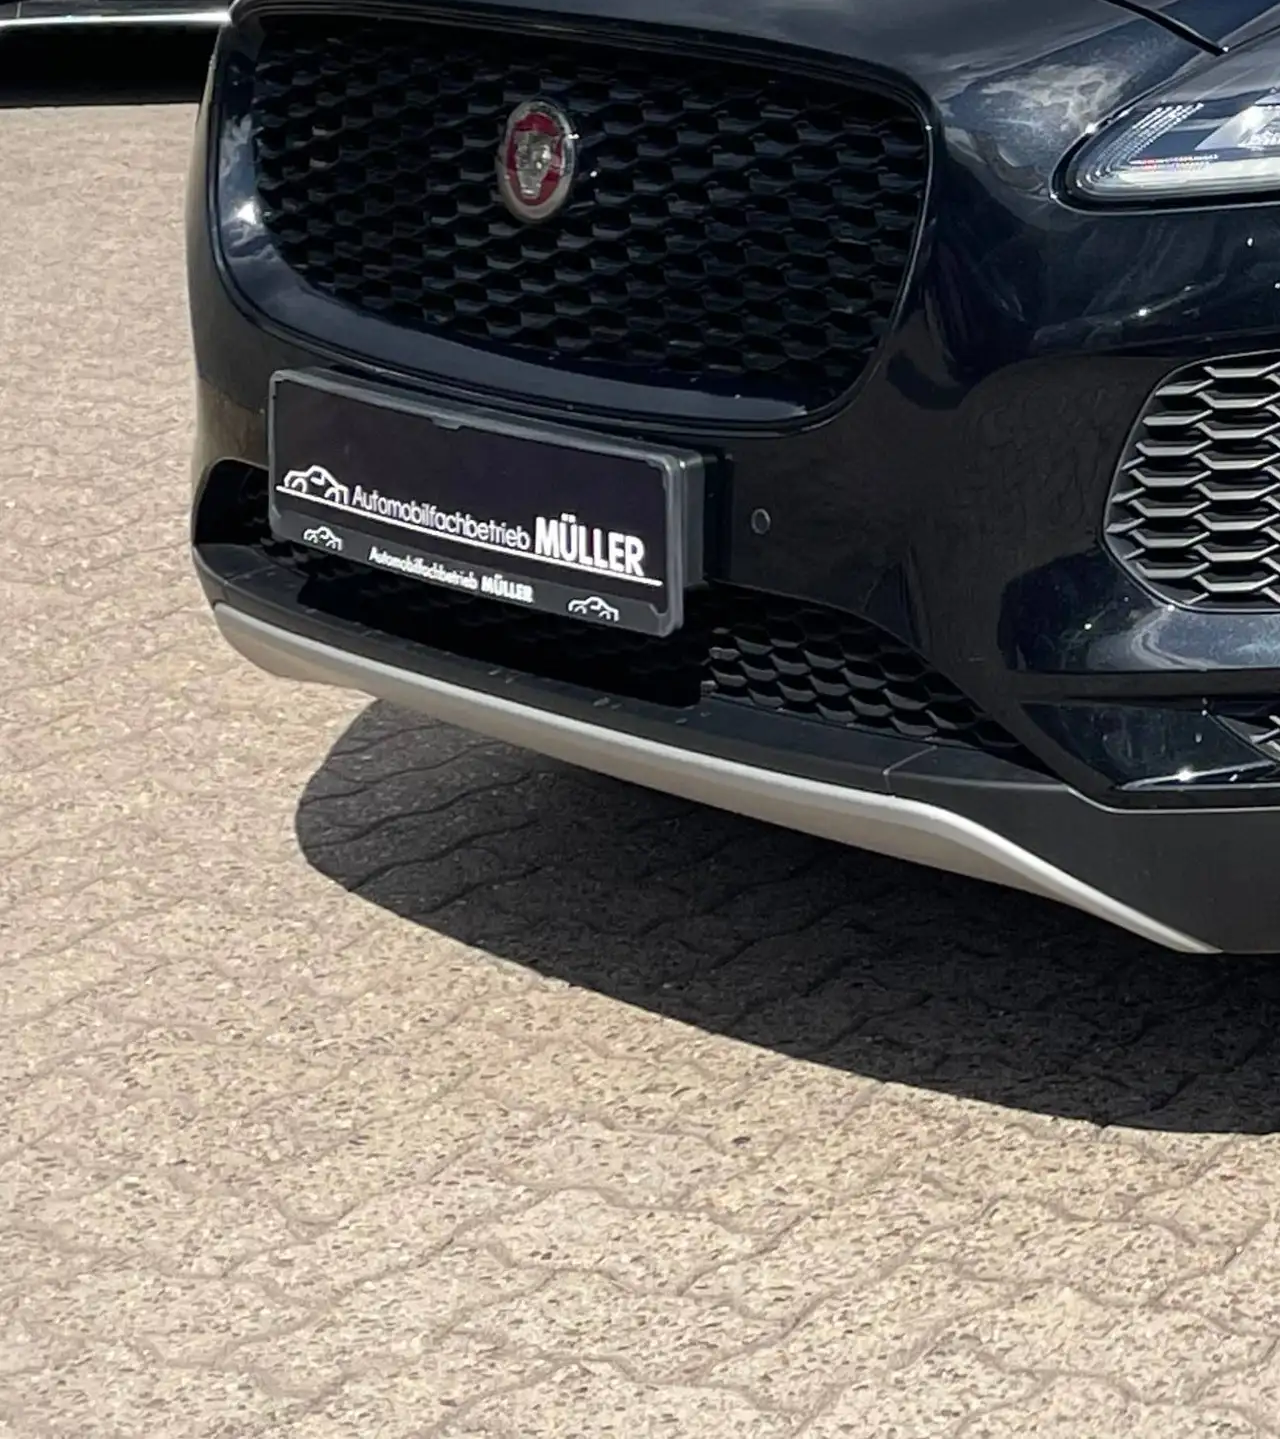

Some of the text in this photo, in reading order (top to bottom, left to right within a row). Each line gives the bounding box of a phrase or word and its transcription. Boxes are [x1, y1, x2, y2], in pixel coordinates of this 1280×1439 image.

[352, 485, 646, 578] Automobilfachbetrieb MÜLLER
[368, 546, 535, 603] Automobilfachbetrieb MÜLLER
